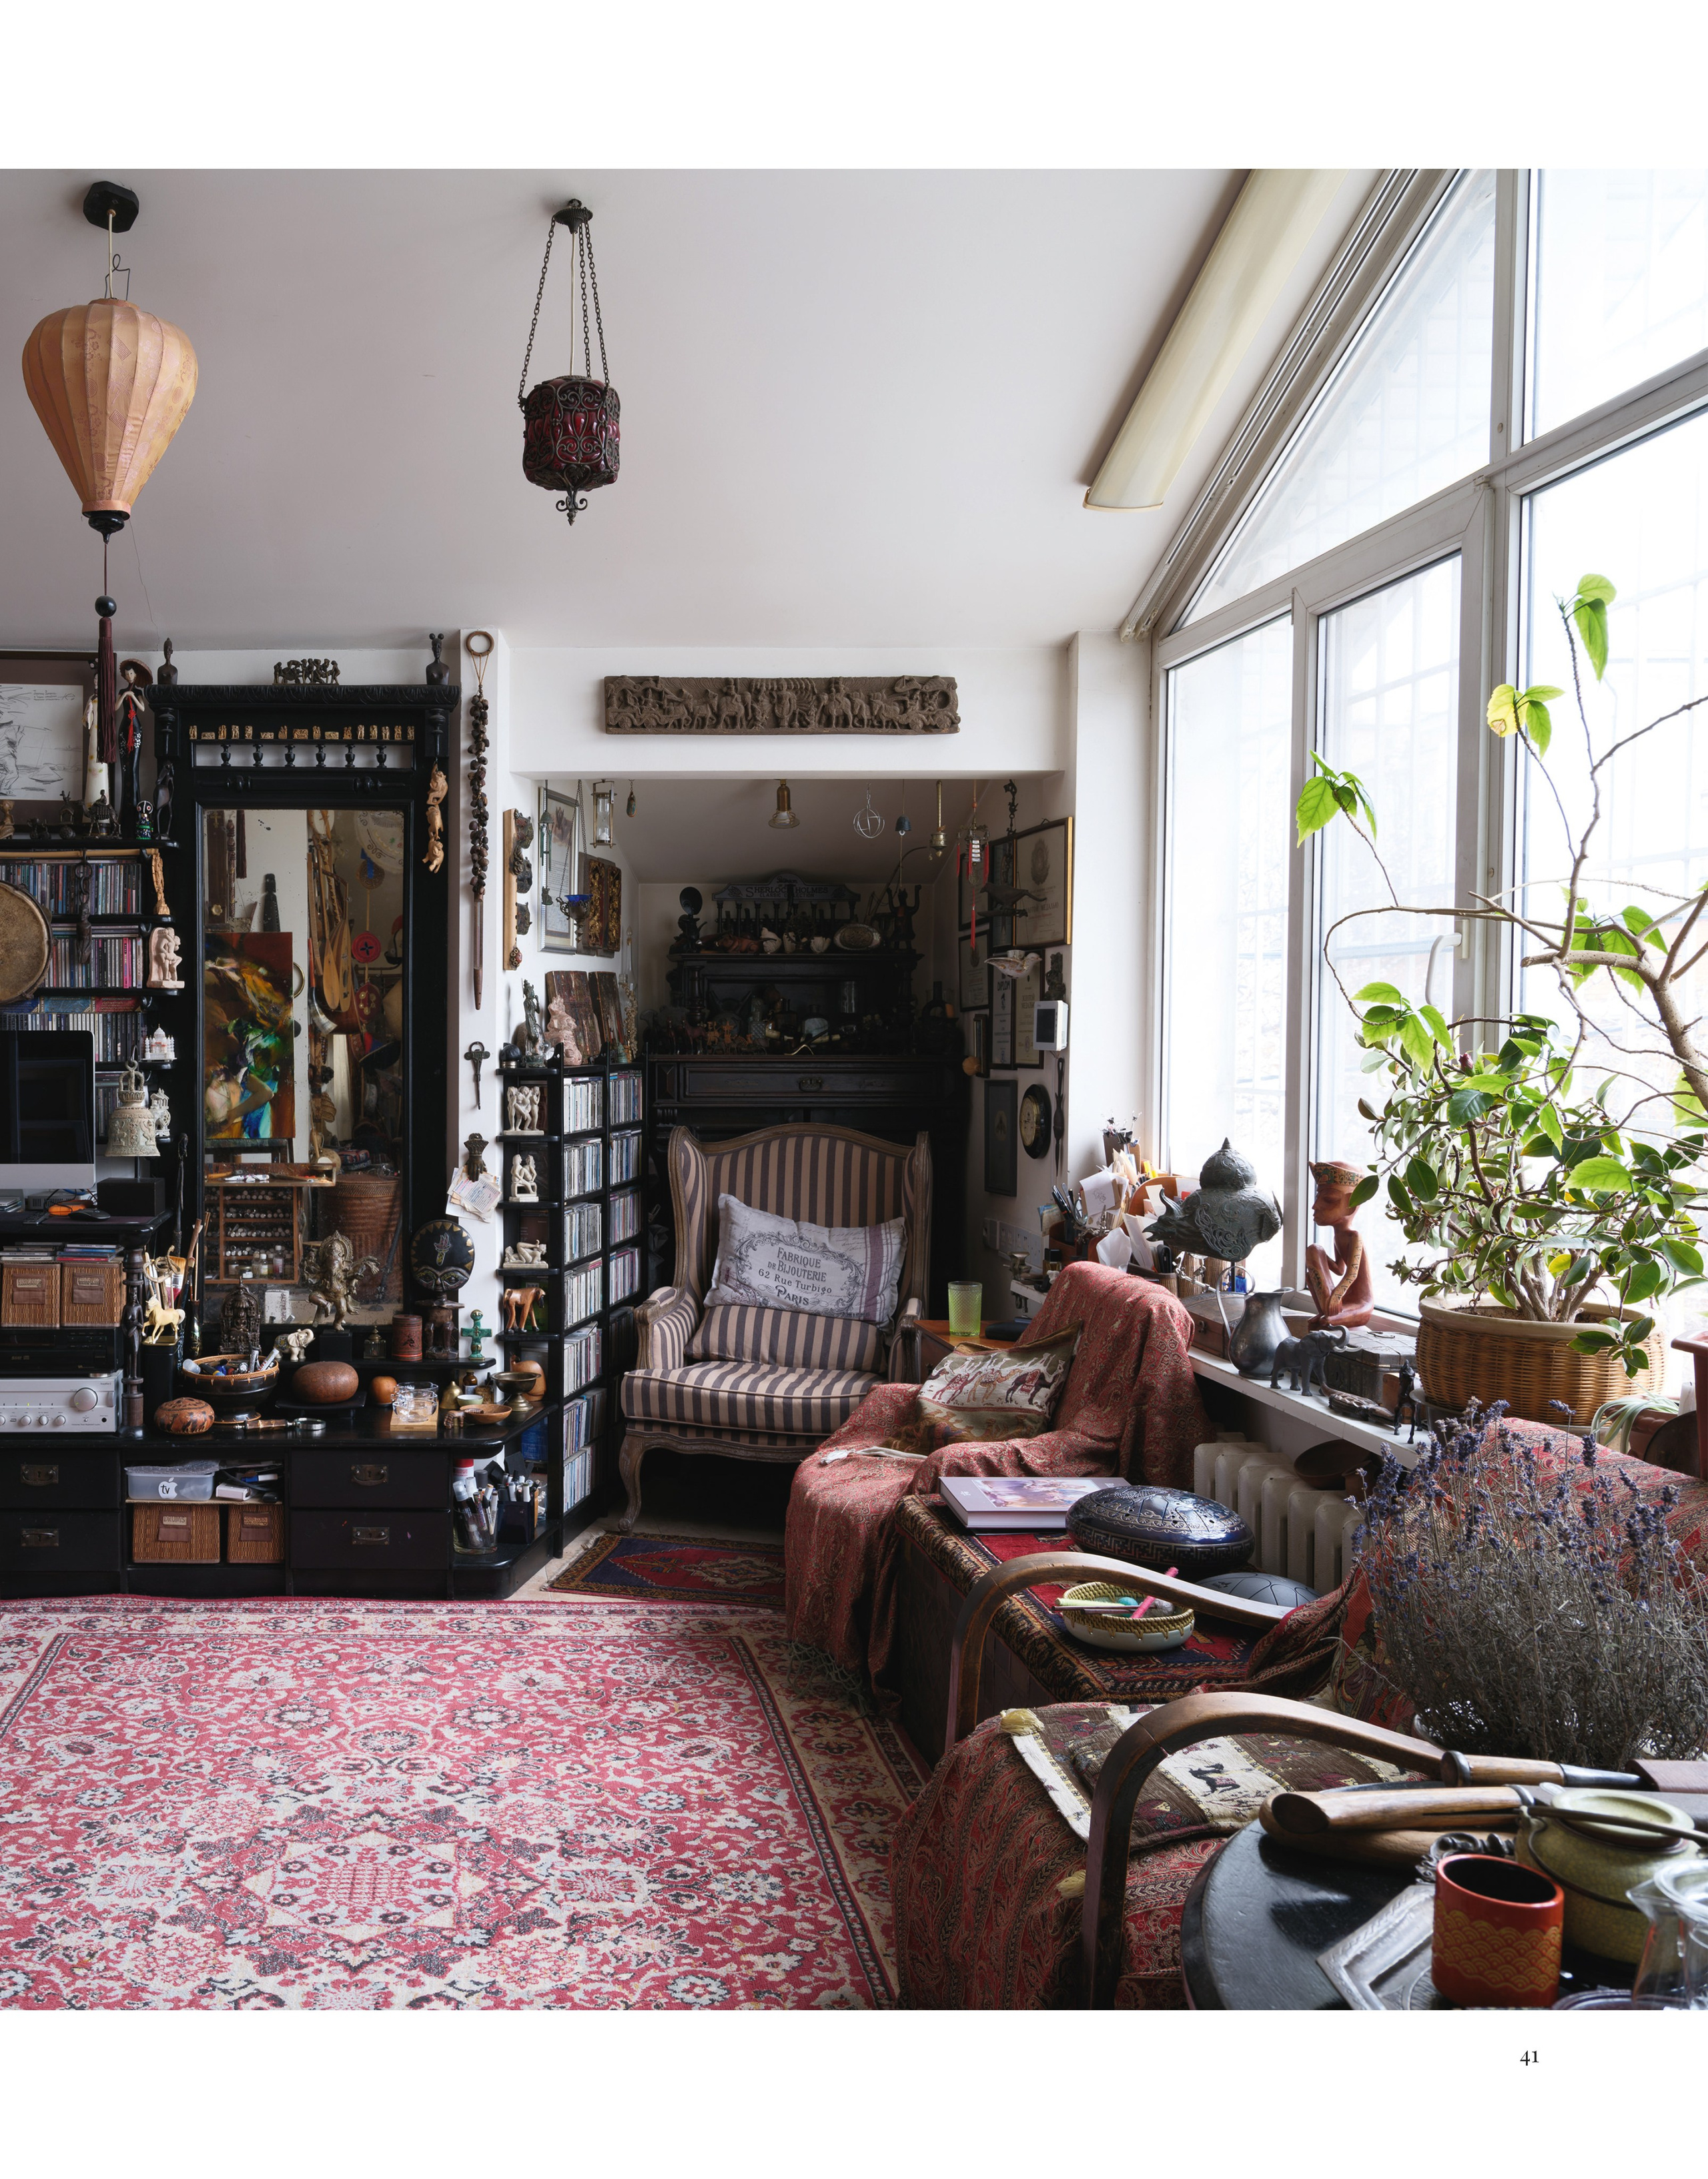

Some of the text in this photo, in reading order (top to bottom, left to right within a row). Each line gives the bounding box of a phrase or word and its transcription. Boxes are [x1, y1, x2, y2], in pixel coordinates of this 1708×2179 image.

[745, 887, 786, 897] SHERLOC
[997, 980, 1011, 991] DIPLOM
[777, 1247, 821, 1268] FABRIQUE
[767, 1260, 827, 1282] DE BIJOUTERIE
[758, 1268, 833, 1295] 62 Rue Turbigo
[160, 1484, 170, 1494] tv
[163, 1515, 185, 1523] DRUMS
